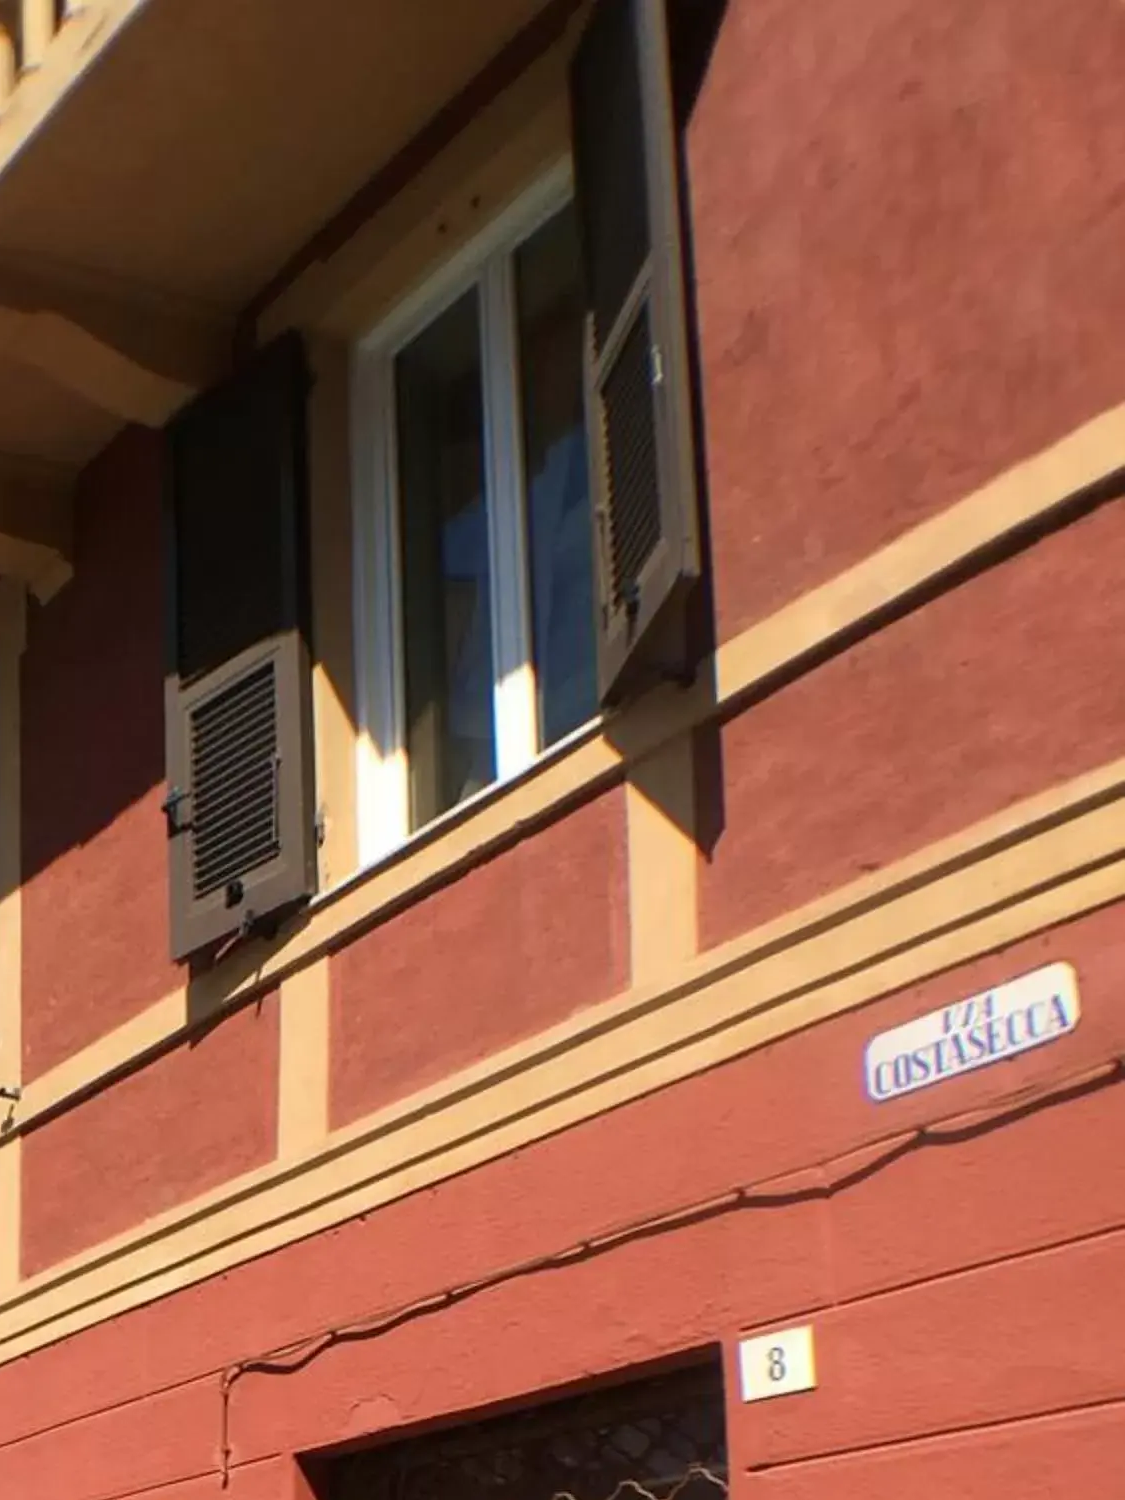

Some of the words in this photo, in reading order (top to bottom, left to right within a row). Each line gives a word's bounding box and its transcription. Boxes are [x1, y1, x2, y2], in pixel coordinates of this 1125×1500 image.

[942, 993, 995, 1034] VIA
[874, 994, 1070, 1095] COSTASECCA
[767, 1346, 787, 1382] 8
